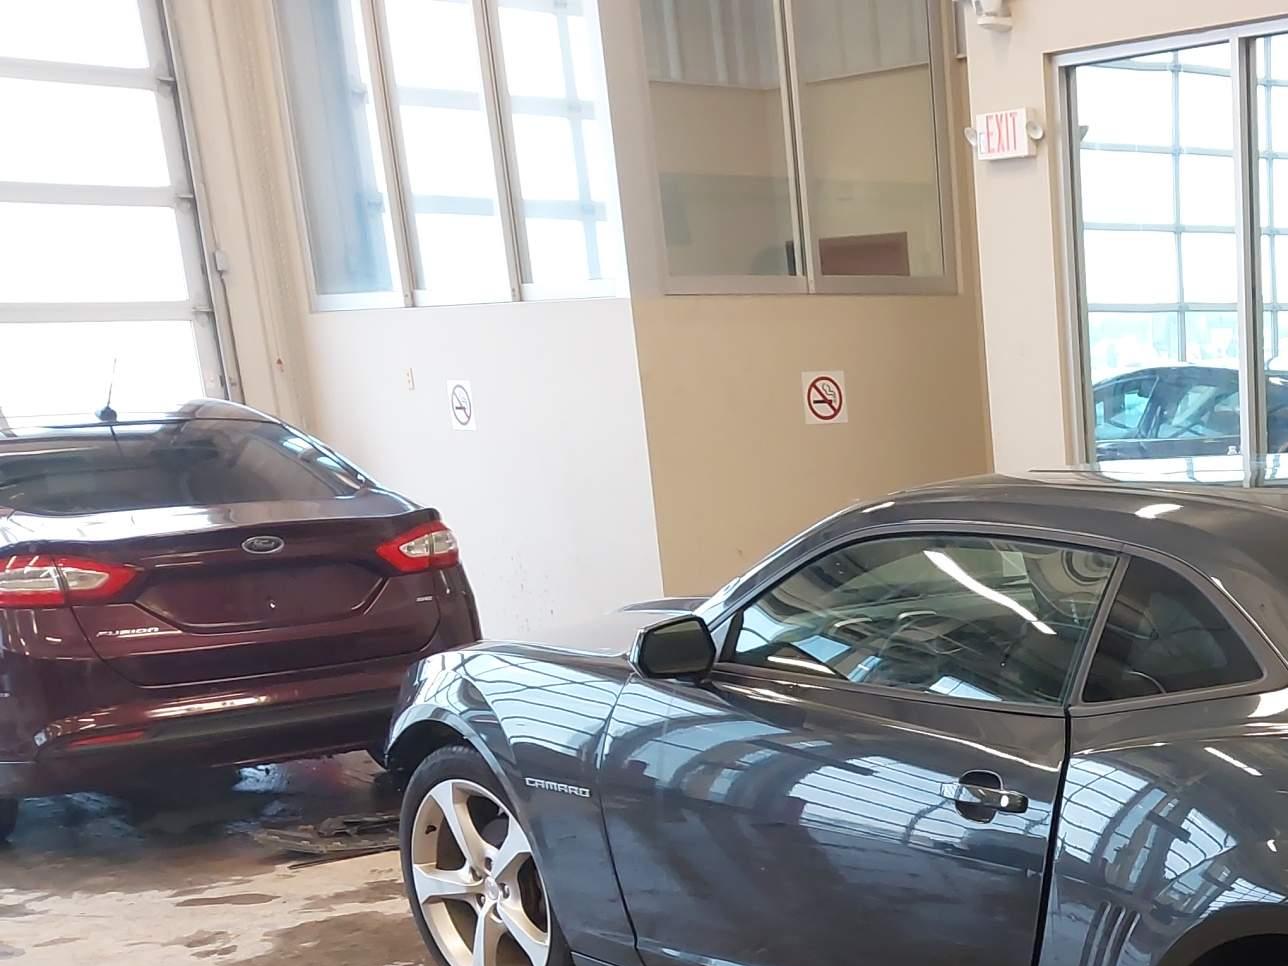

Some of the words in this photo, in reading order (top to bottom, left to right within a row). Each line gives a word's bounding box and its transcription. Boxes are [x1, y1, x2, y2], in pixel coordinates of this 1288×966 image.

[985, 111, 1018, 154] EXIT
[96, 626, 159, 638] FUSION
[524, 777, 590, 797] CAMARO
